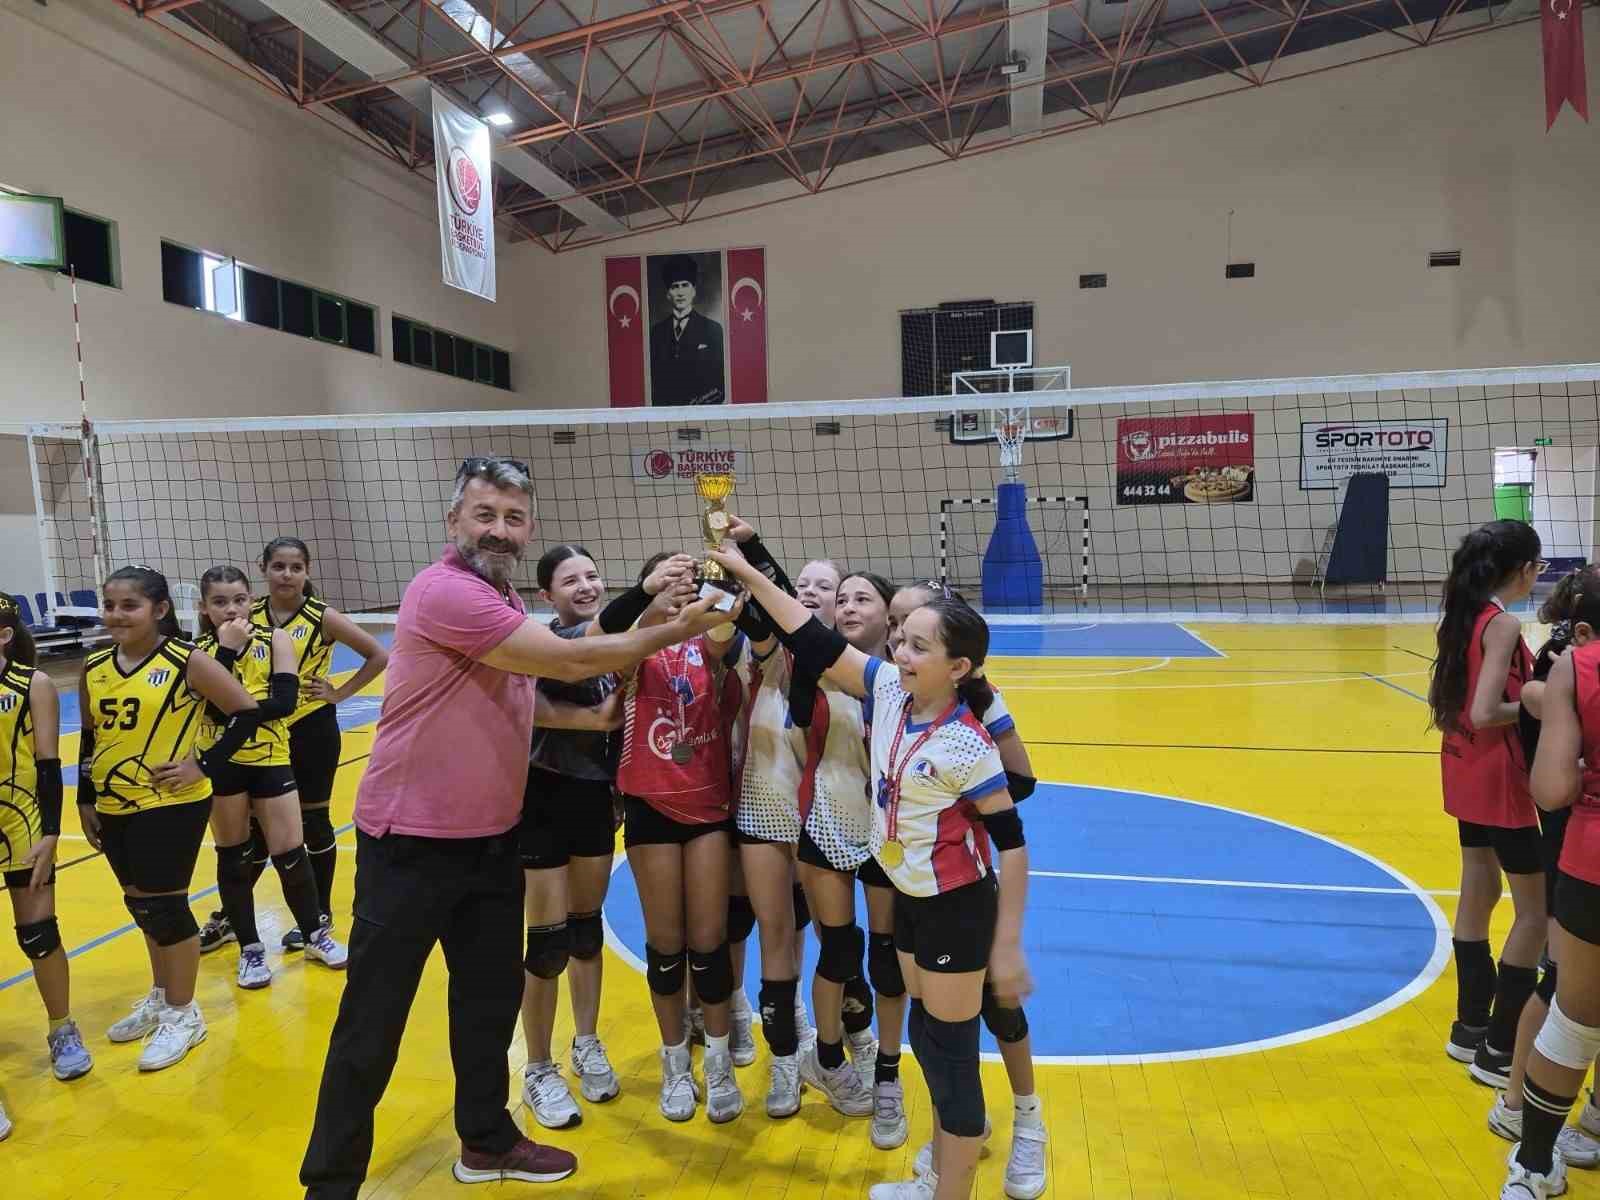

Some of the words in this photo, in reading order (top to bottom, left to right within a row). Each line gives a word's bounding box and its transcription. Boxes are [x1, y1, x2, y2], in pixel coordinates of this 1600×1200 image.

[1158, 430, 1249, 449] pizzabulls
[1315, 430, 1433, 448] SPORTOTO
[677, 448, 736, 463] TÜRKİYE
[1123, 485, 1142, 497] 444
[1144, 485, 1156, 497] 32
[1158, 484, 1171, 496] 44
[99, 697, 141, 731] 53
